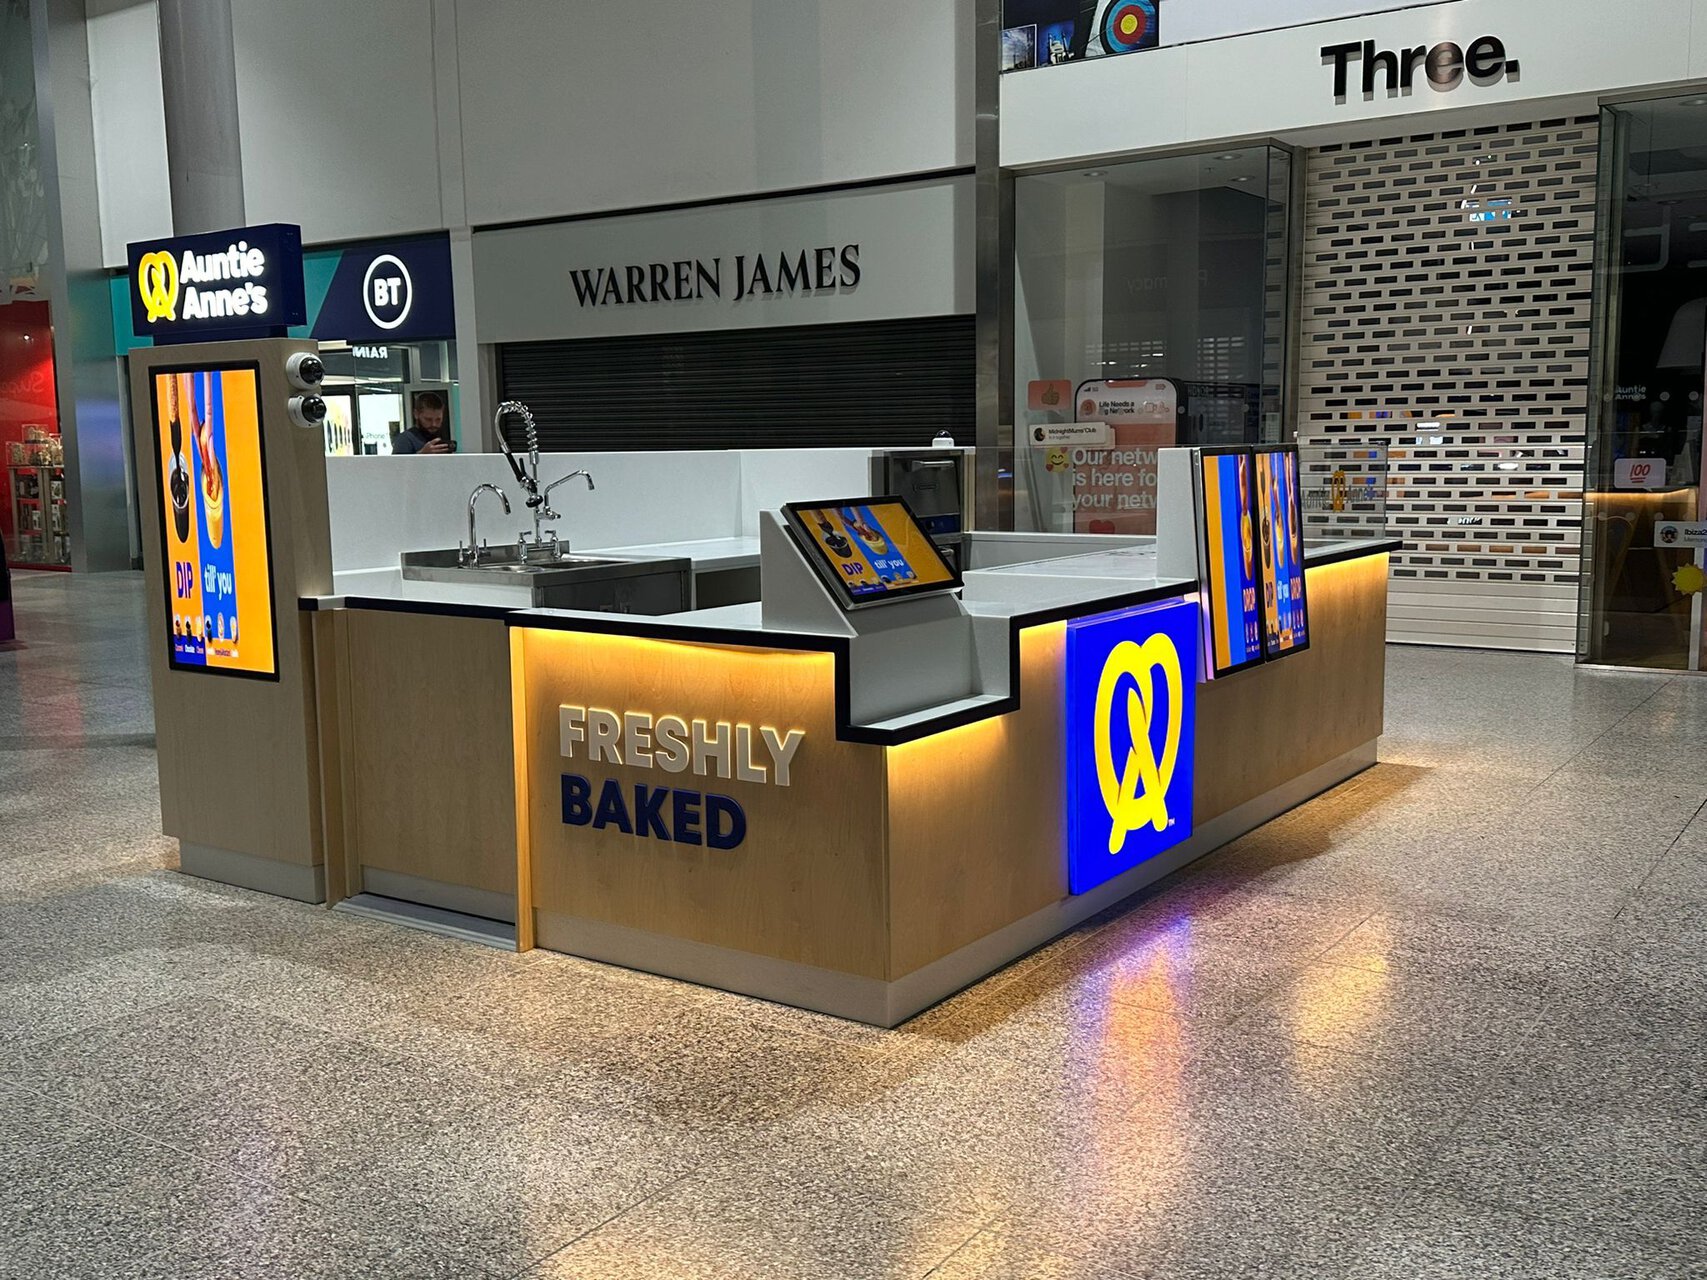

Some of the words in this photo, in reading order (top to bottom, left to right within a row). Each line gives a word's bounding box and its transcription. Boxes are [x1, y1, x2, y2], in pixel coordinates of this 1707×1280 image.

[1320, 36, 1519, 98] Three.
[179, 240, 265, 285] Auntie
[569, 257, 721, 308] WARREN
[732, 244, 862, 301] JAMES
[182, 282, 269, 320] Anne's
[373, 278, 401, 306] BT
[1072, 447, 1107, 465] Our
[1111, 447, 1157, 465] netw
[1072, 469, 1087, 487] is
[1091, 468, 1134, 487] here
[1138, 468, 1157, 487] fo
[1072, 493, 1114, 511] your
[175, 561, 194, 599] DIP
[841, 561, 864, 576] DIP
[887, 559, 905, 570] you
[216, 572, 233, 601] you
[559, 703, 806, 787] FRESHLY
[560, 772, 747, 850] BAKED
